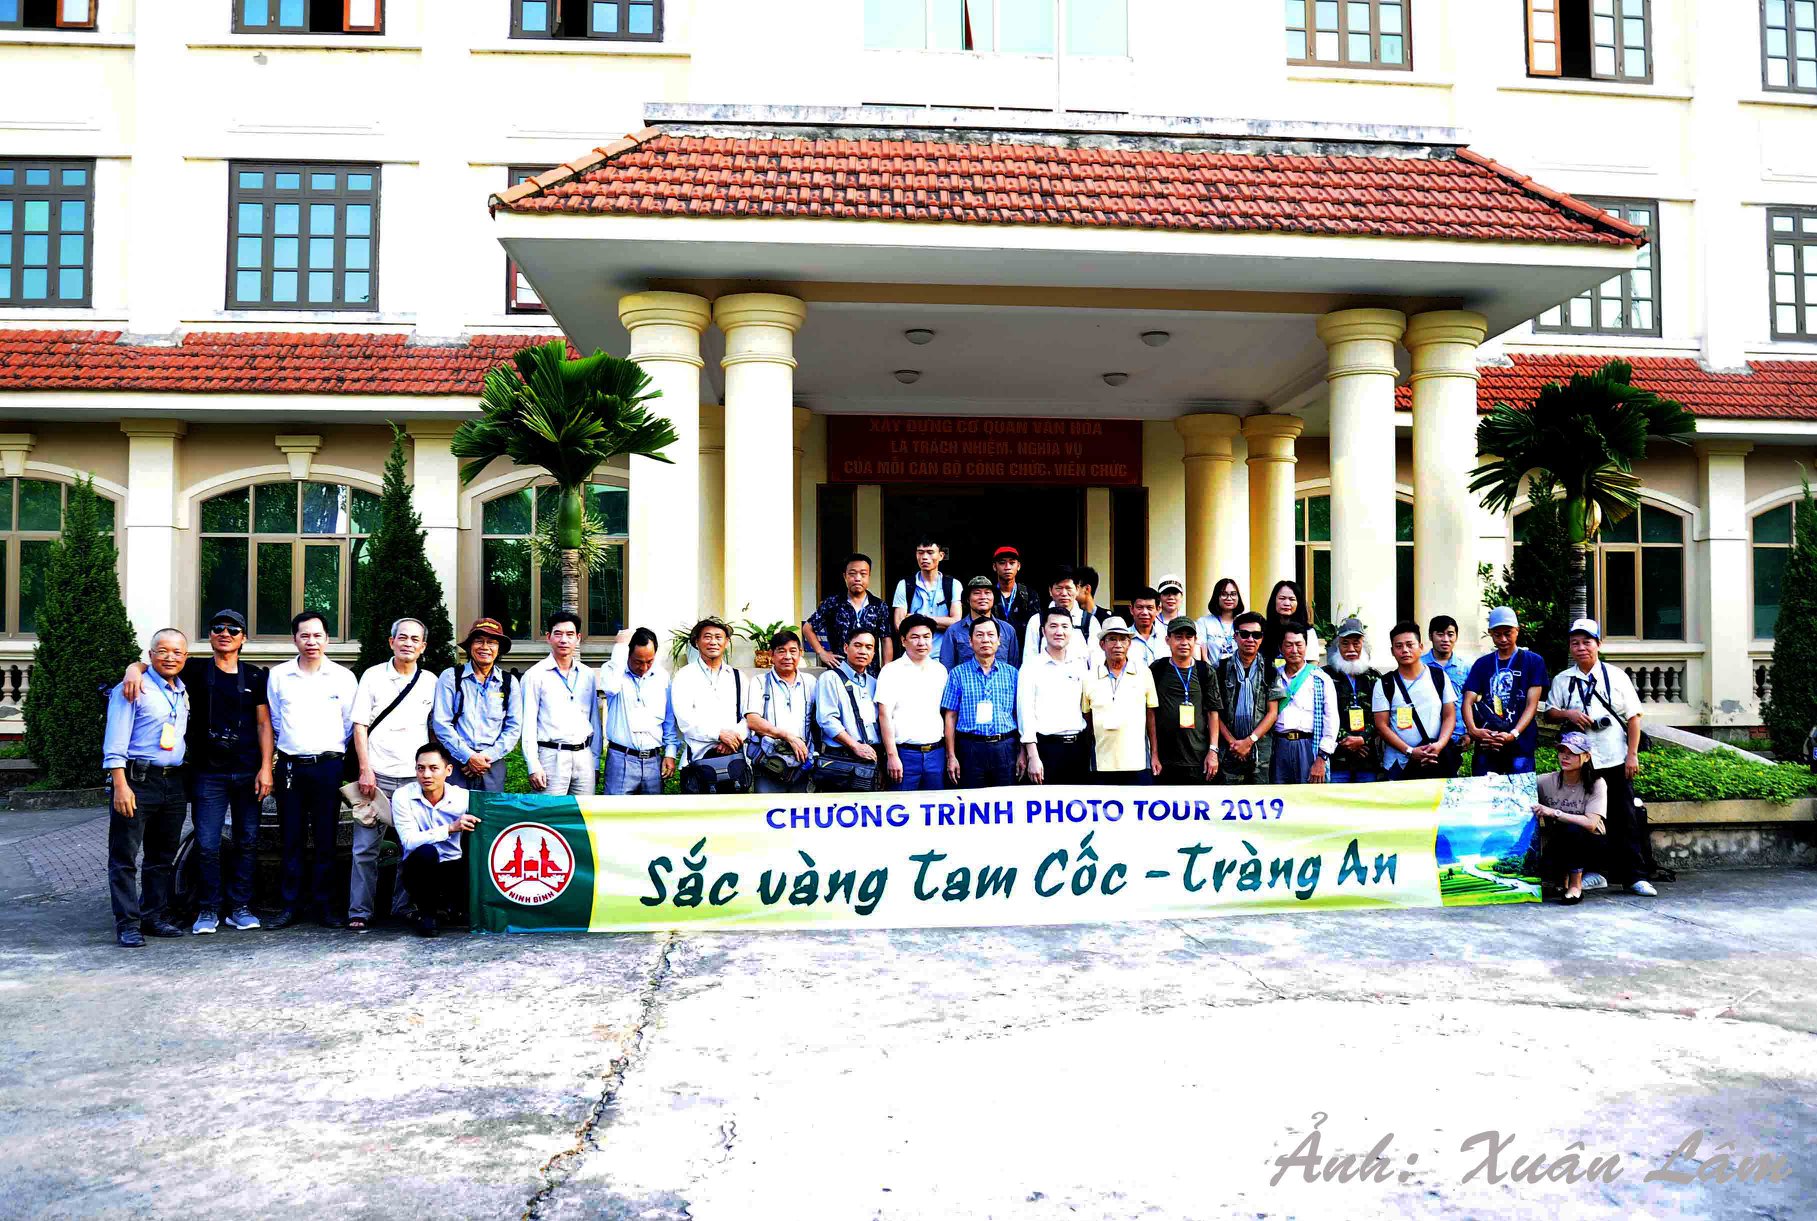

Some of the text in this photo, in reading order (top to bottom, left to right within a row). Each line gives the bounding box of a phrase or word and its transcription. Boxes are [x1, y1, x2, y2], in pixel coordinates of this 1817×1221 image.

[766, 796, 1285, 829] CHƯƠNG TRÌNH PHOTO TOUR 2019
[639, 836, 739, 909] Sắc
[756, 850, 889, 916] vàng
[908, 849, 1018, 903] Tam
[1033, 830, 1128, 898] Cốc
[1177, 839, 1322, 901] Tràng
[1337, 838, 1398, 886] An
[508, 890, 555, 903] NINH BÌNH
